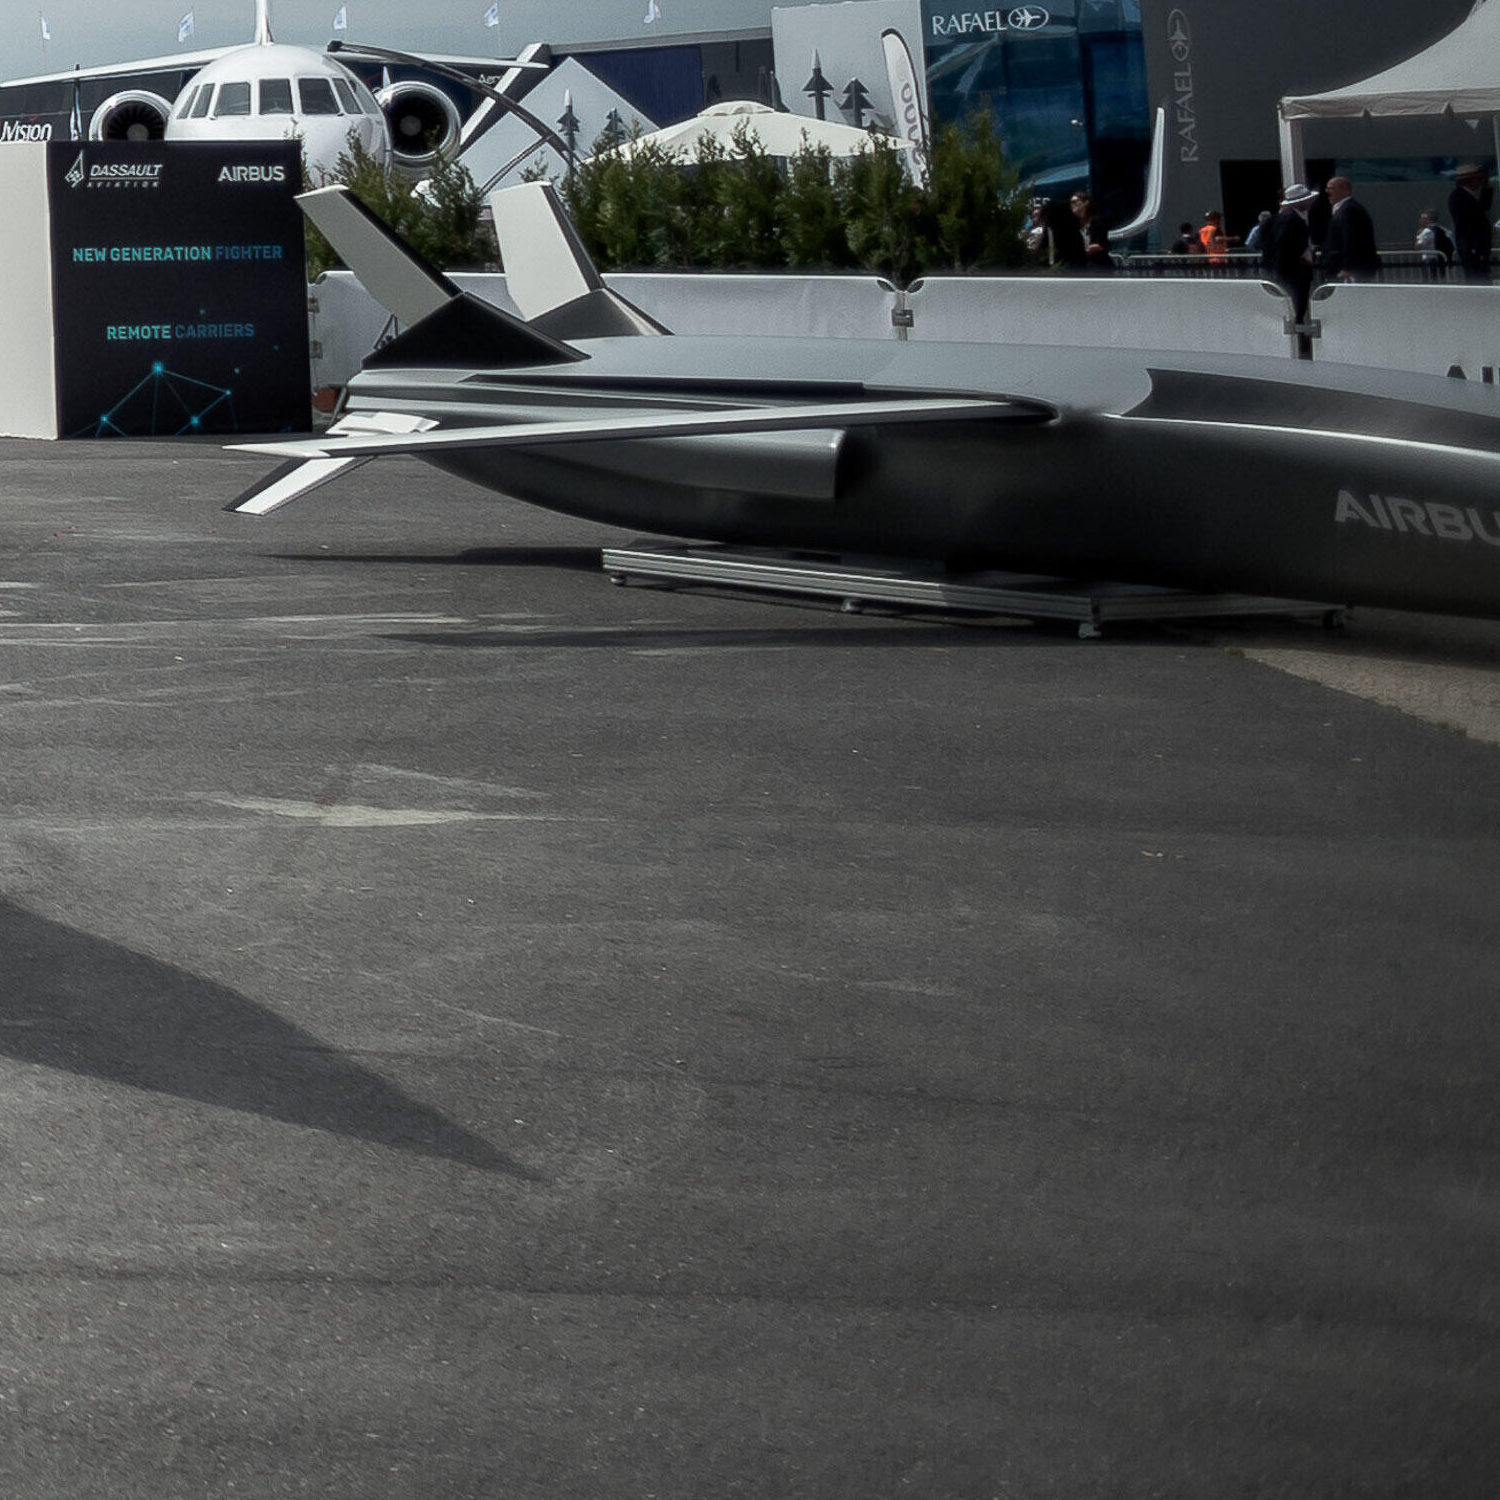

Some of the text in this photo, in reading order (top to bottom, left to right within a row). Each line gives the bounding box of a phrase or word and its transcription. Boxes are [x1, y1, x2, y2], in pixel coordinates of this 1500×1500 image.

[931, 11, 1008, 36] RAFAEL
[1173, 62, 1200, 163] RAFAEL
[90, 164, 164, 177] DASSAULT
[217, 165, 285, 182] AIRBUS
[87, 181, 159, 189] AVIATION
[72, 245, 283, 262] NEW GENERATION FIGHTER
[106, 323, 255, 340] REMOTE CARRIERS
